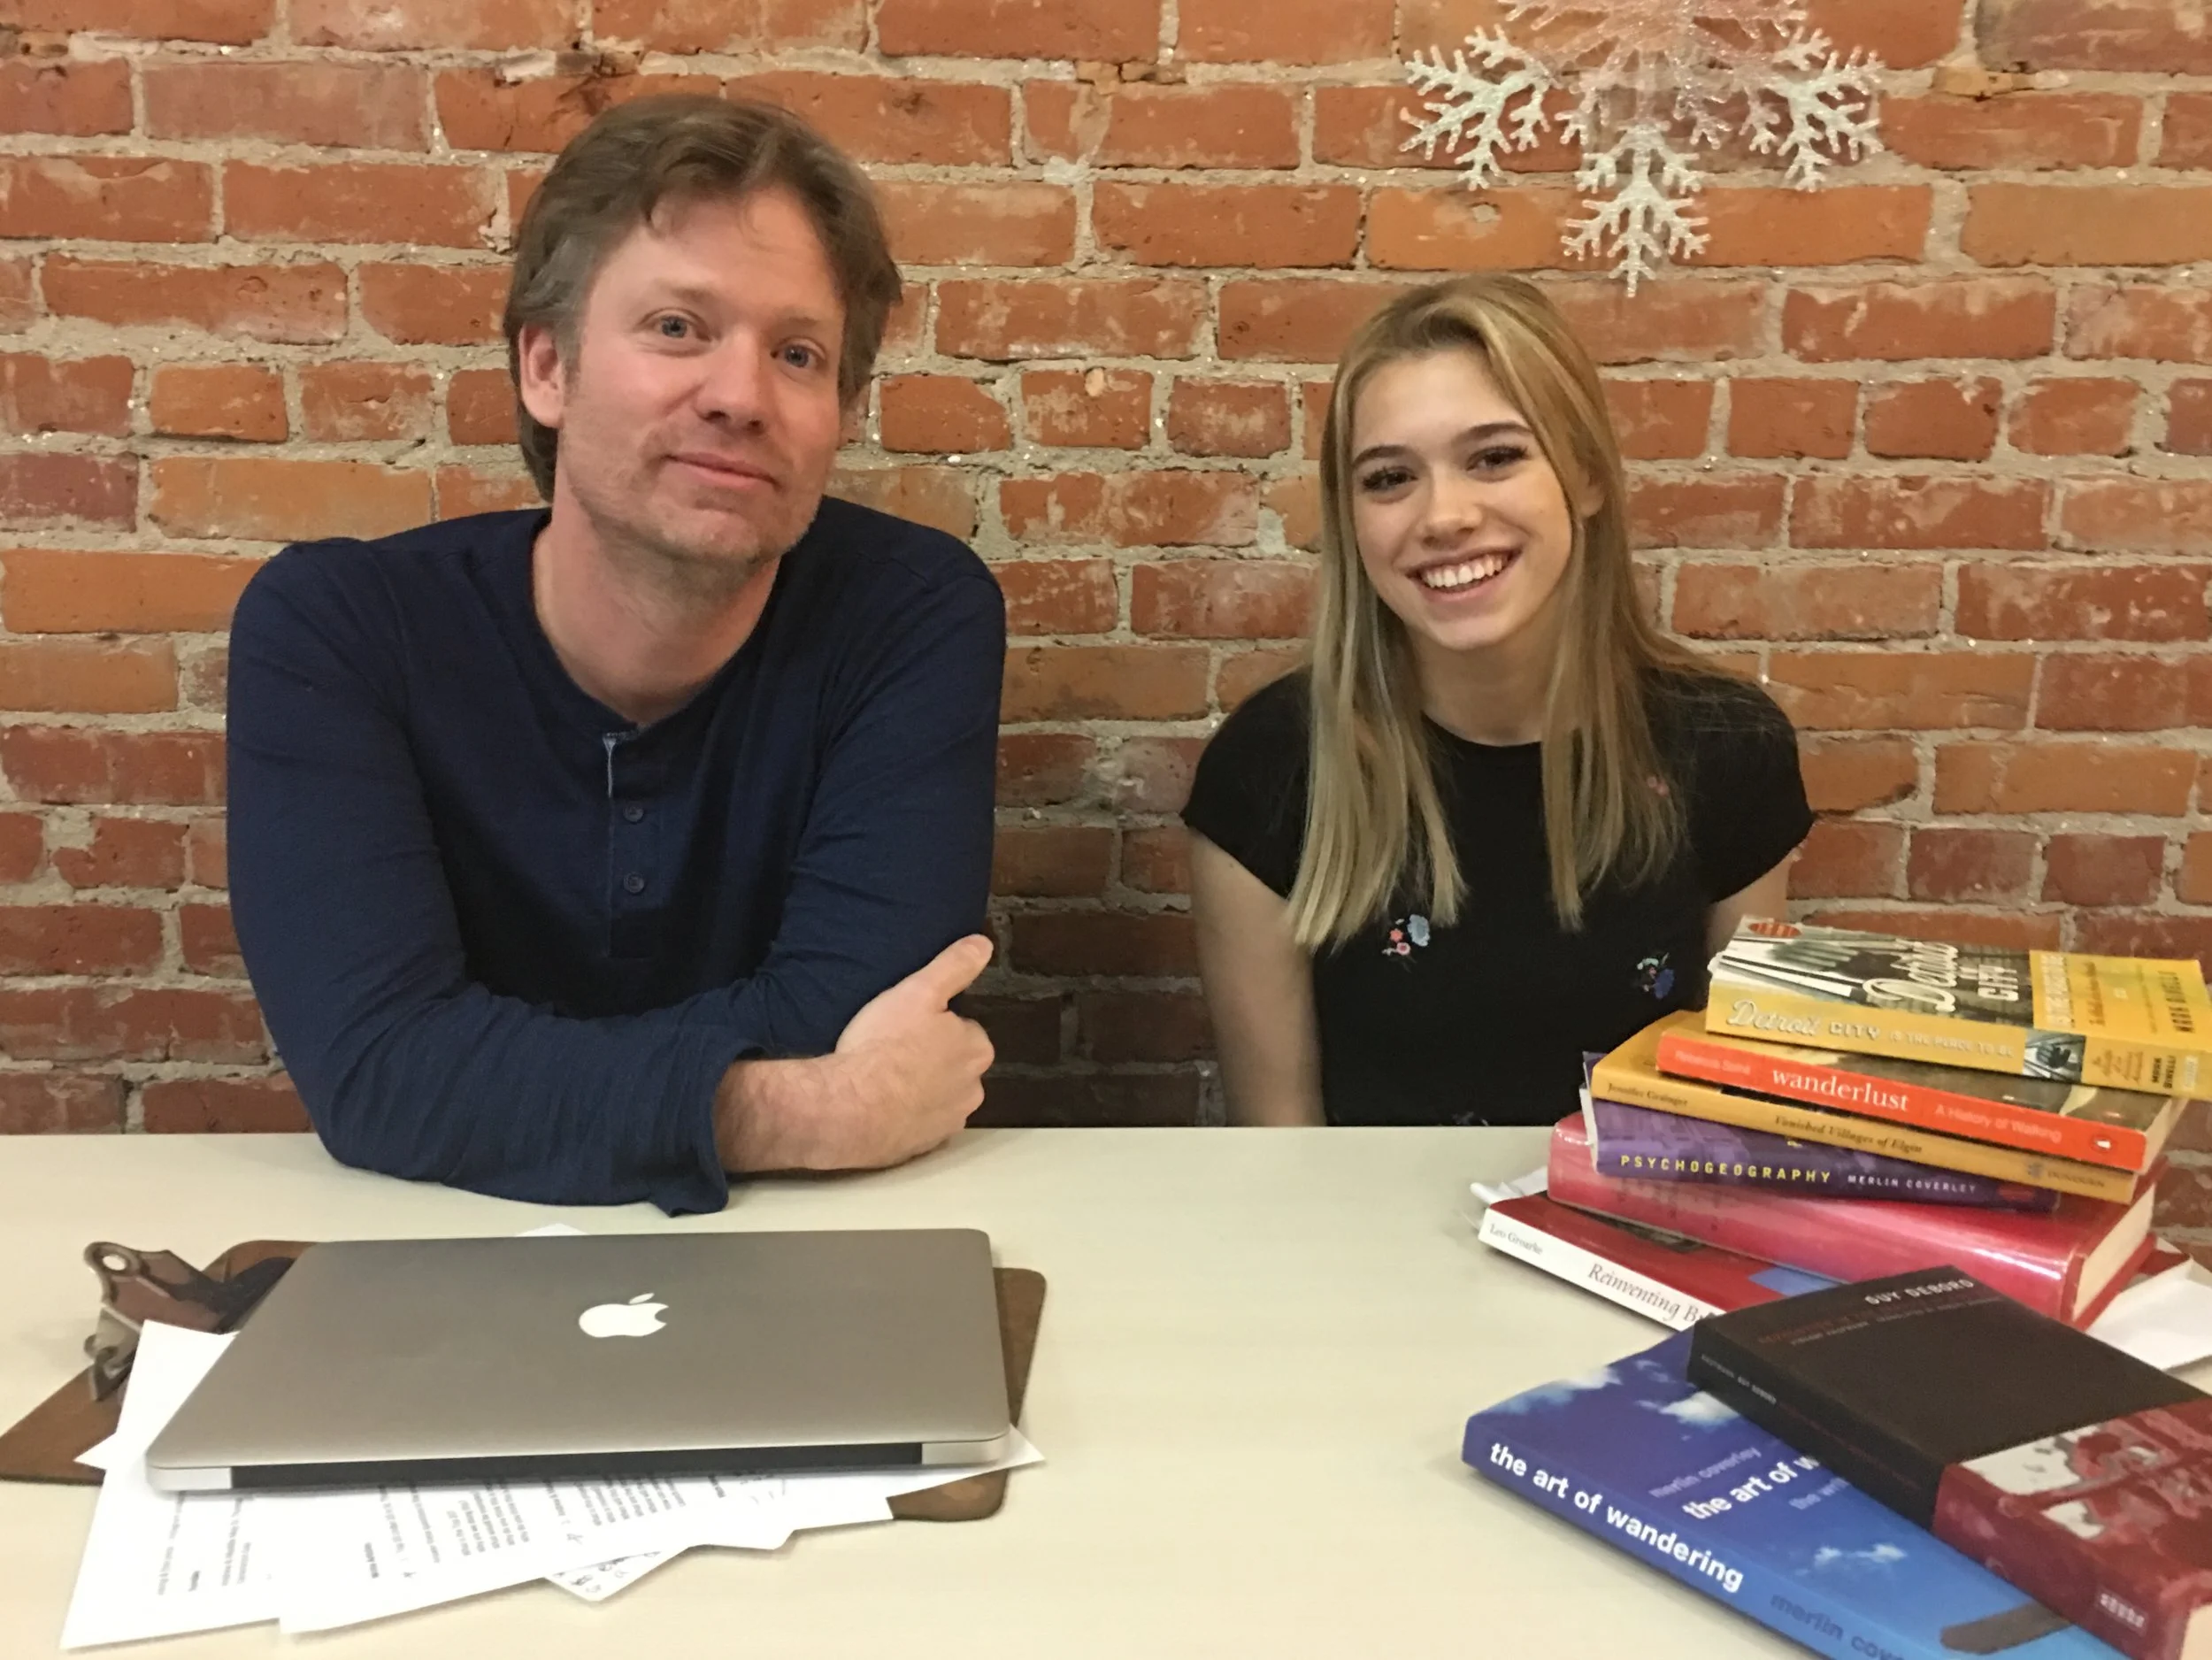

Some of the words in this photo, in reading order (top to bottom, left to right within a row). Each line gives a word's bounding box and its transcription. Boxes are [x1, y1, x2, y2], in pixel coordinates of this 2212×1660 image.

[1726, 1000, 1821, 1036] Detroit
[1828, 1021, 1881, 1041] CITY
[1772, 1069, 1910, 1112] wanderlust
[1935, 1103, 1946, 1116] A
[1949, 1108, 1992, 1128] History
[1995, 1118, 2009, 1130] of
[2010, 1118, 2062, 1143] Walking
[1775, 1115, 1826, 1135] Vanished
[1829, 1124, 1873, 1145] Villages
[1877, 1136, 1890, 1149] of
[1620, 1154, 1832, 1184] PSYCHOGEOGRAPHY
[1847, 1174, 1900, 1188] MERLIN
[1906, 1179, 1977, 1194] COVERLEY
[1489, 1224, 1507, 1239] Leo
[1586, 1263, 1681, 1322] Reinventing
[1864, 1290, 1901, 1305] GUY
[1904, 1279, 1975, 1299] DEBORD
[1682, 1497, 1732, 1519] the
[1729, 1475, 1773, 1502] art
[1769, 1460, 1799, 1484] of
[1490, 1442, 1527, 1477] the
[1532, 1468, 1570, 1499] art
[1574, 1490, 1603, 1515] of
[1606, 1505, 1745, 1594] wandering
[1770, 1594, 1845, 1642] merlin
